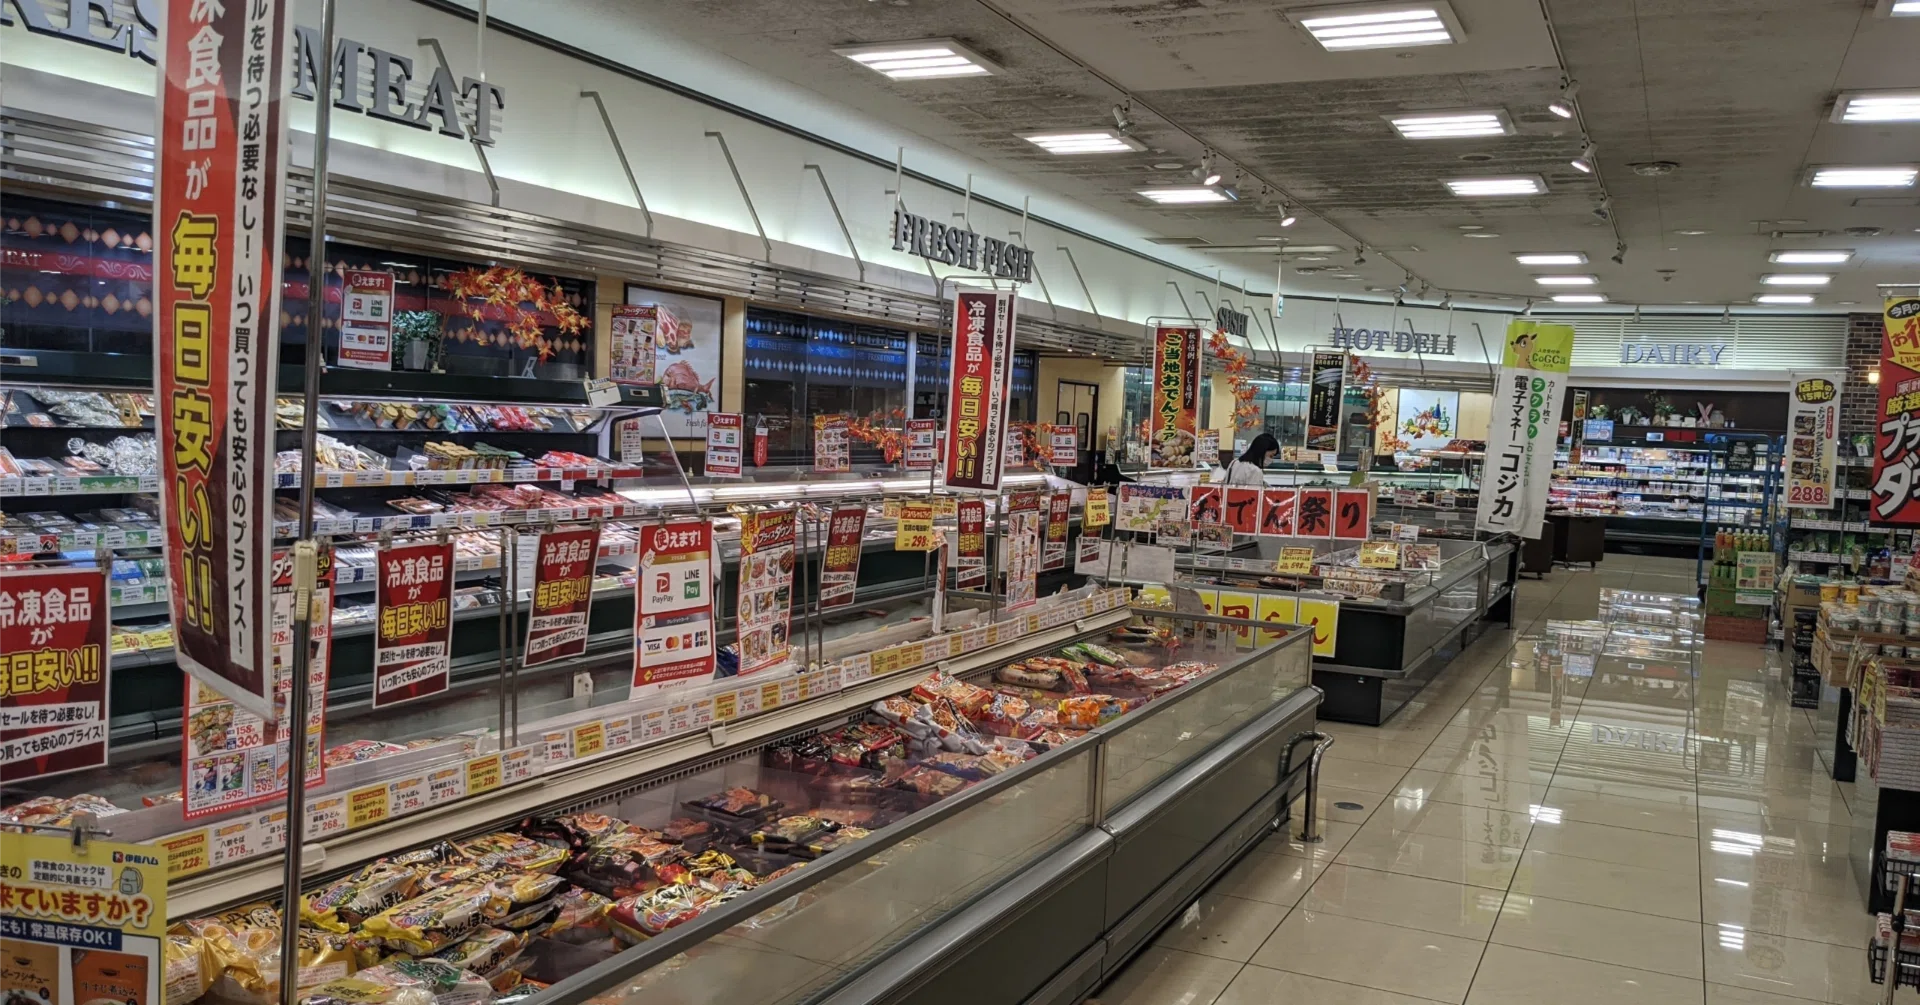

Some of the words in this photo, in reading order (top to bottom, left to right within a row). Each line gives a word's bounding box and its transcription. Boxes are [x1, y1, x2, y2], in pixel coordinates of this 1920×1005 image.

[291, 25, 505, 148] MEAT
[892, 210, 981, 272] FRESH
[981, 235, 1035, 284] FISH
[1891, 302, 1920, 318] 今月の
[1217, 307, 1249, 338] SUSHI
[1332, 327, 1390, 352] HOT
[1393, 332, 1457, 356] DELI
[1621, 343, 1727, 365] DAIRY
[1161, 333, 1183, 442] ご当地おでんフェア
[841, 534, 848, 543] が
[911, 535, 927, 547] 298
[542, 538, 592, 565] 冷凍食品
[387, 555, 444, 588] 冷凍食品
[559, 565, 571, 577] が
[684, 570, 700, 580] LINE
[407, 586, 422, 600] が
[536, 577, 589, 610] 毎日安い!!
[686, 586, 699, 596] Pay
[652, 594, 674, 604] PayPay
[382, 600, 447, 639] 毎日安い!!
[30, 625, 56, 645] が
[647, 642, 661, 651] VISA
[0, 705, 95, 728] セールを待つ必要なし!
[515, 767, 527, 777] 198
[396, 790, 420, 800] ちゃんぽん
[441, 788, 455, 798] 278
[404, 798, 418, 808] 258
[368, 808, 382, 819] 218
[322, 819, 338, 831] 268
[228, 845, 246, 858] 278
[33, 860, 106, 876] 非常食のストックは
[182, 857, 200, 870] 228
